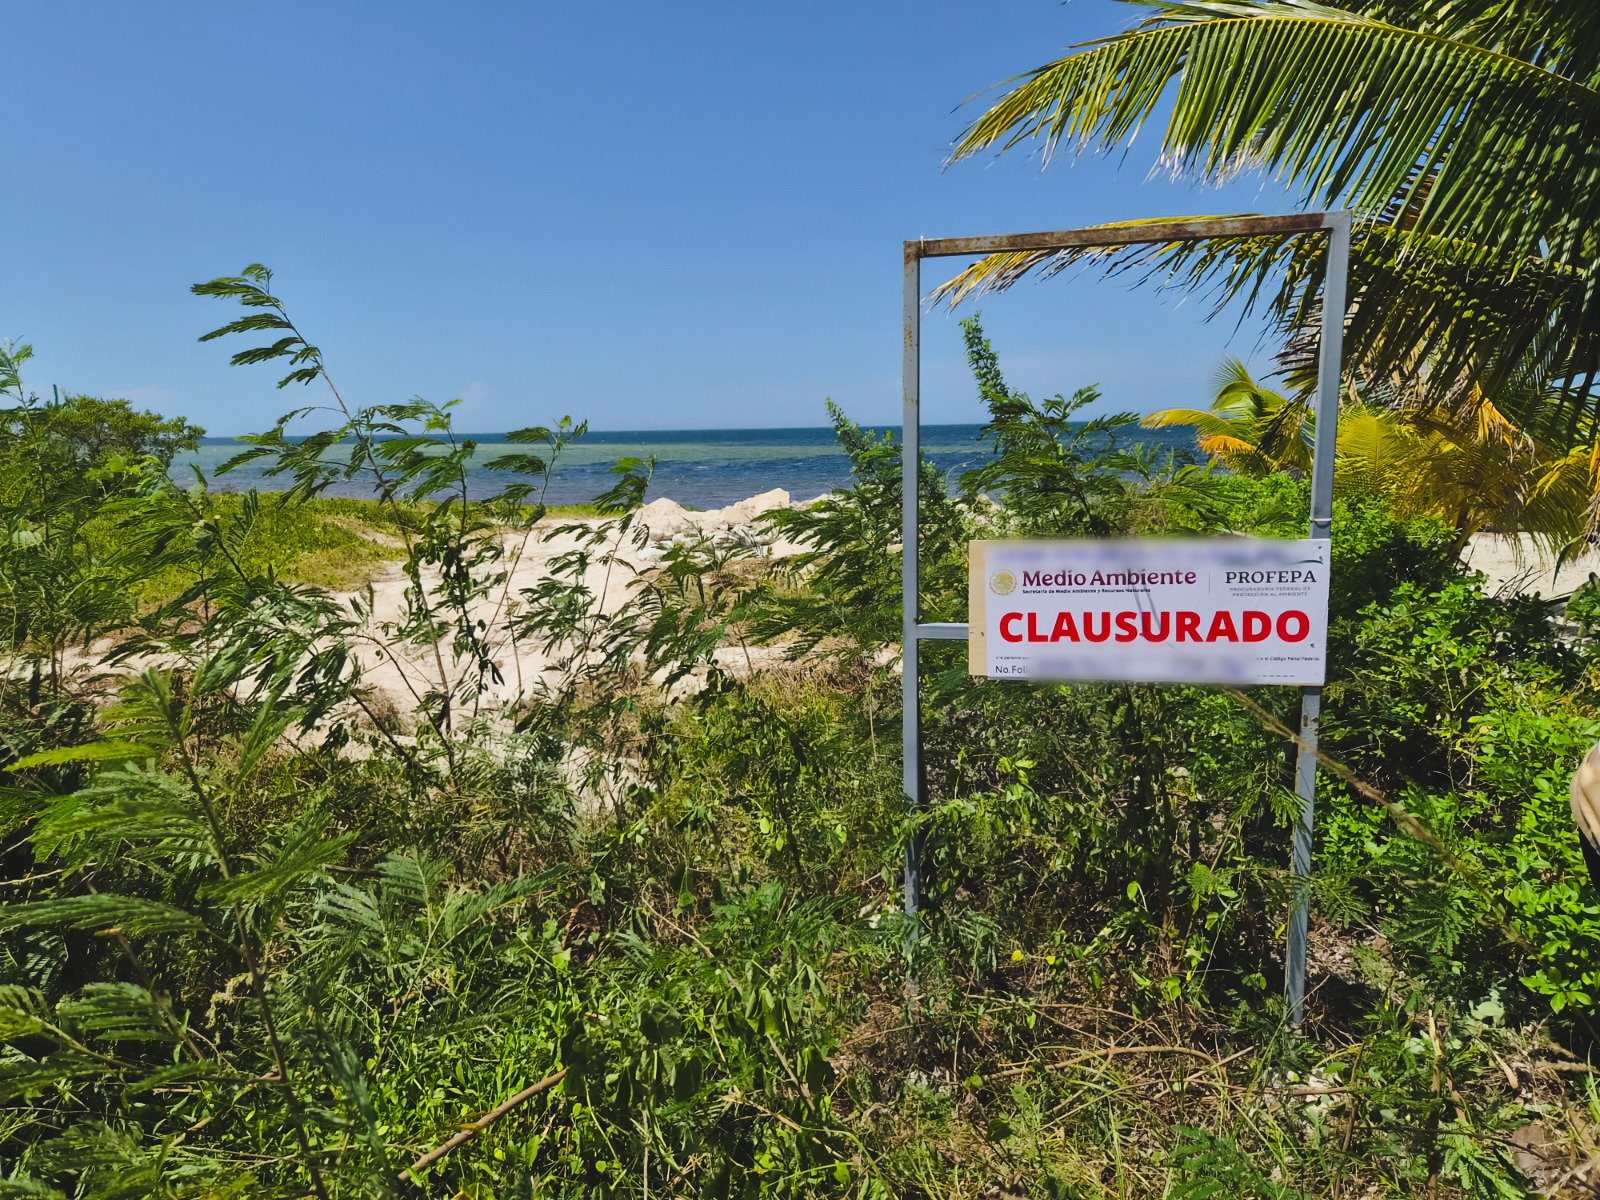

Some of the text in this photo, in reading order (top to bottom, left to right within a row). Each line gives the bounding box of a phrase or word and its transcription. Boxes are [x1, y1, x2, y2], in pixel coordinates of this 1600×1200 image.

[1022, 568, 1197, 587] Medio Ambiente
[1225, 570, 1317, 584] PROFEPA
[999, 609, 1311, 644] CLAUSURADO
